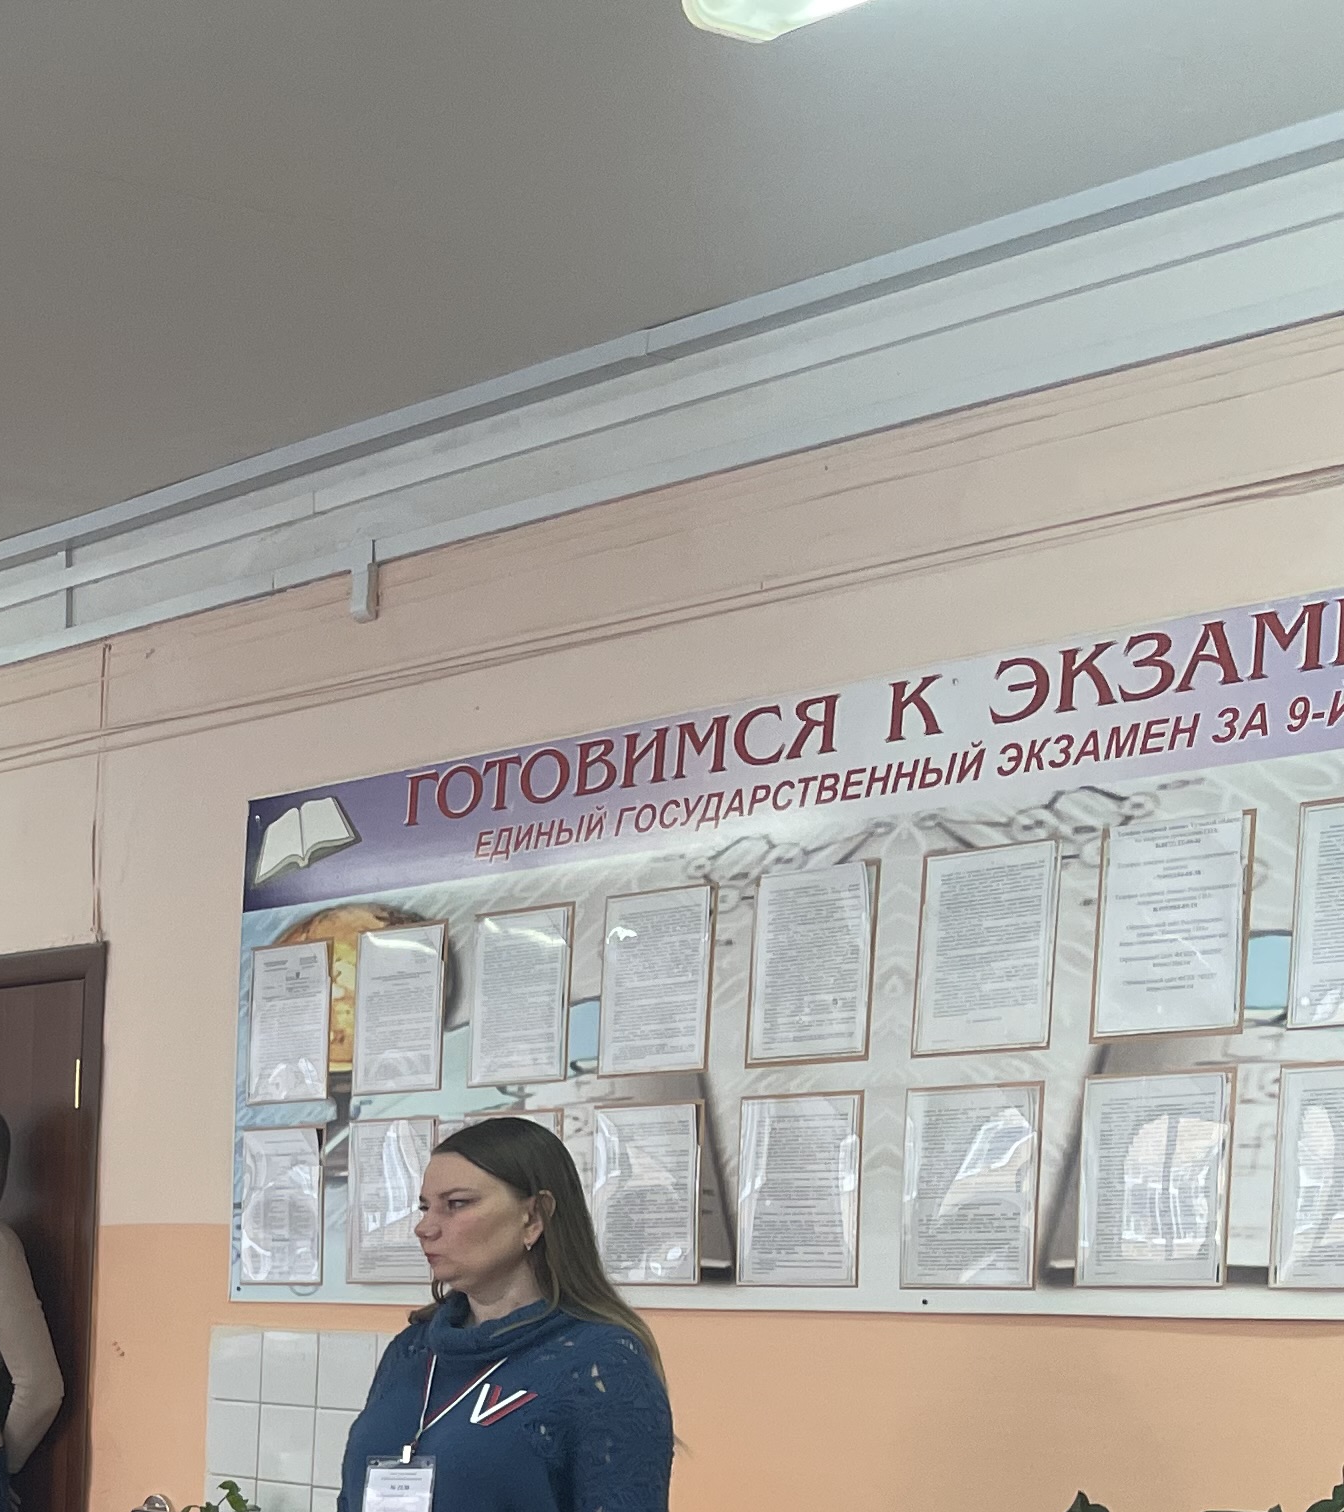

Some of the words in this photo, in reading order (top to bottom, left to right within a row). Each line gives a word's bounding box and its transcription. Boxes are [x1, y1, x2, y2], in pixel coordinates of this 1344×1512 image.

[403, 695, 839, 827] ГОТОВИМСЯ
[885, 673, 944, 742] К
[474, 804, 607, 861] ЕДИНЫЙ
[614, 741, 985, 837] ГОСУДАРСТВЕННЫЙ
[996, 713, 1201, 776] ЭКЗАМЕН
[1212, 702, 1269, 744] ЗА
